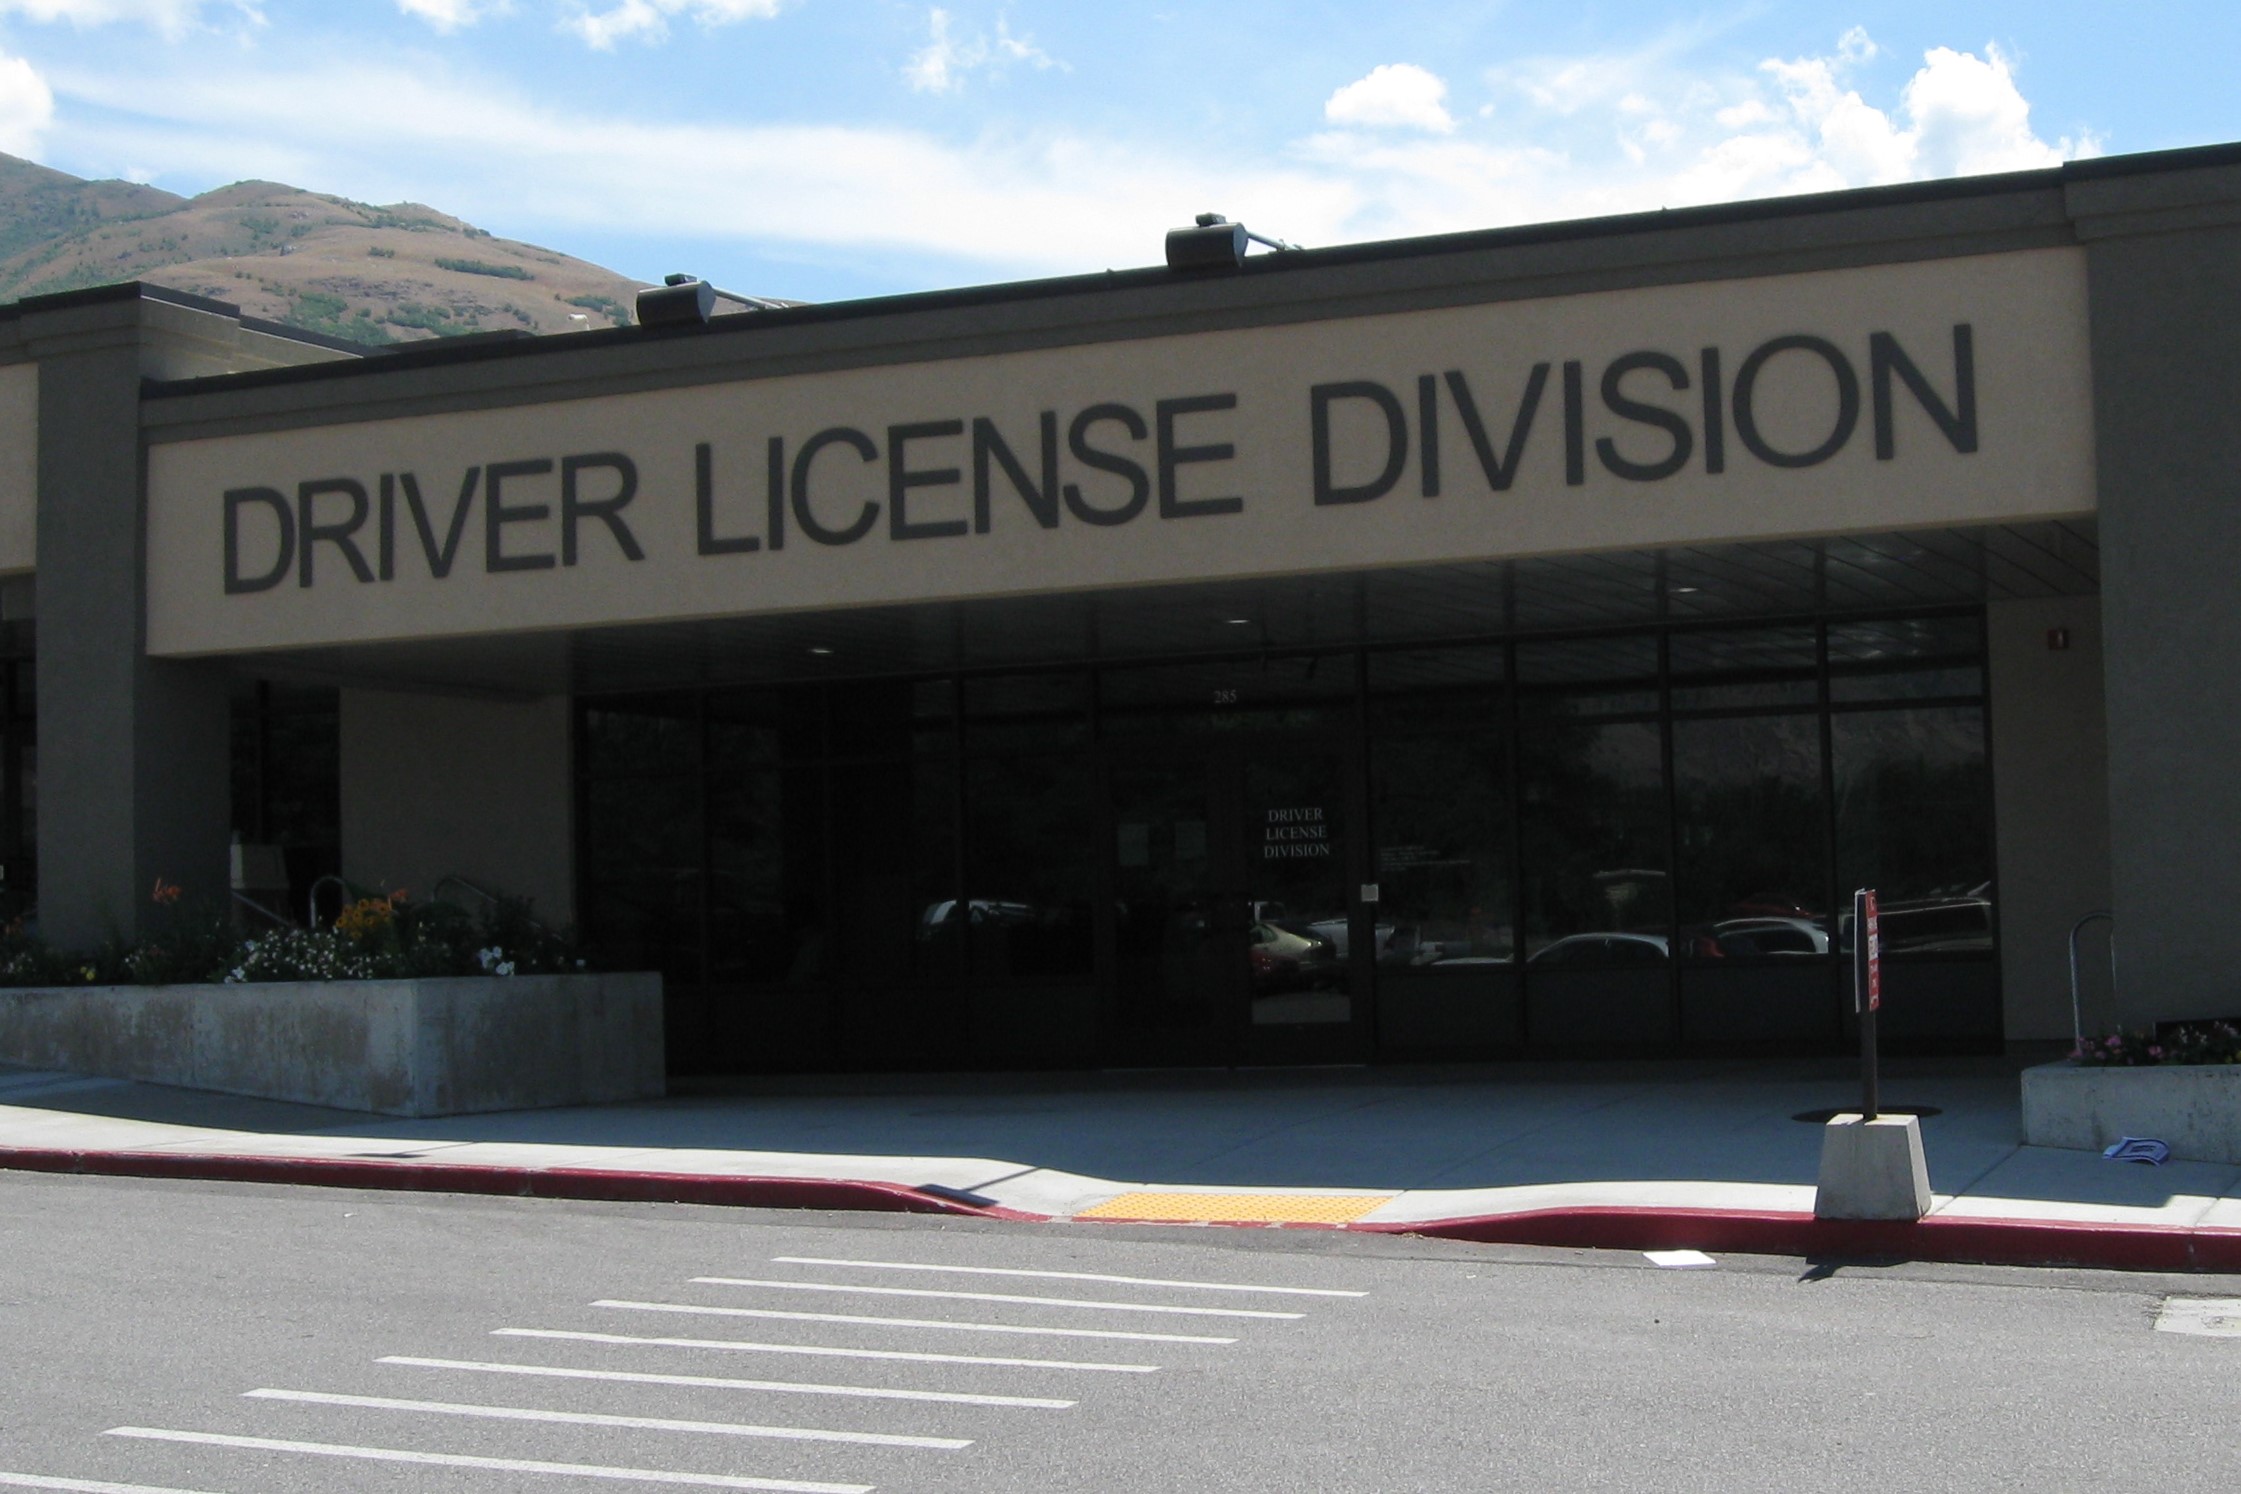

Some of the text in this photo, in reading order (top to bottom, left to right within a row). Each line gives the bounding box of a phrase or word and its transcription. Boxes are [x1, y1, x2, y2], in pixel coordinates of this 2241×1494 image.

[223, 323, 1979, 595] DRIVER LICENSE DIVISION
[1213, 689, 1237, 704] 285
[1268, 807, 1322, 822] DRIVER
[1266, 825, 1328, 840] LICENSE
[1264, 843, 1330, 858] DIVISION
